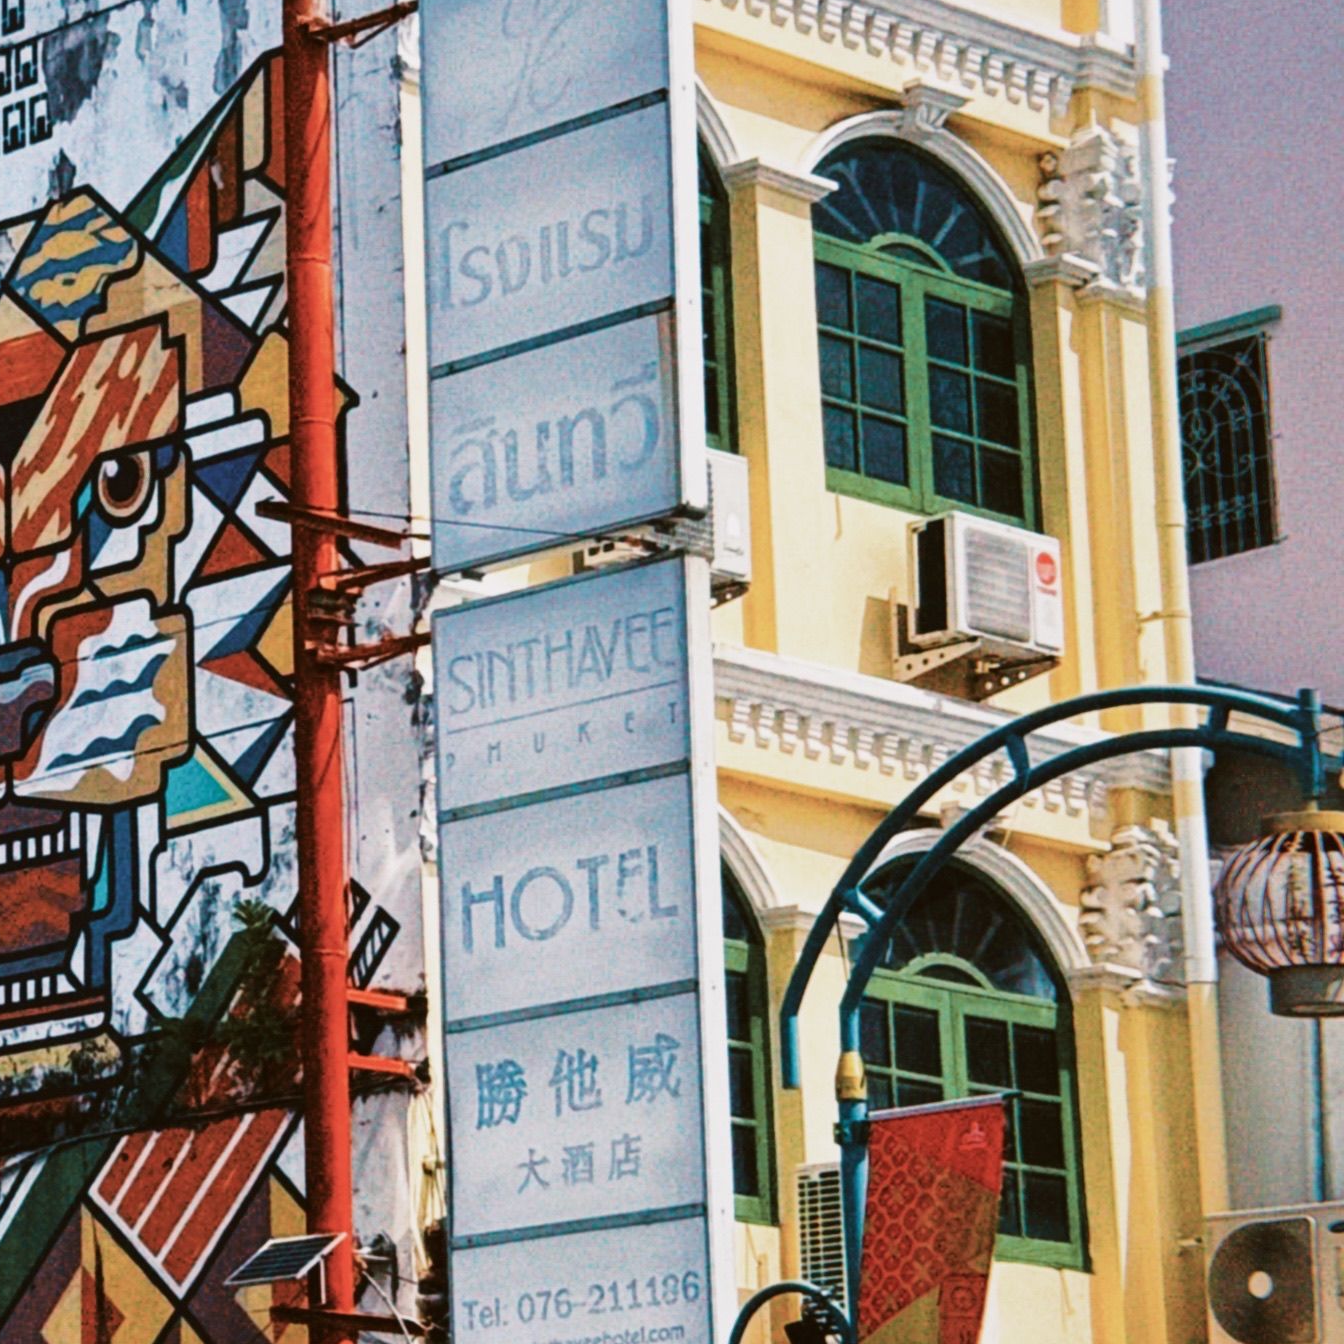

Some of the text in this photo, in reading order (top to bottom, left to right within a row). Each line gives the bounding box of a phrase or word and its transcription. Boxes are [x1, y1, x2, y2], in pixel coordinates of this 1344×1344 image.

[435, 193, 654, 313] โรงแรม
[447, 607, 677, 715] SINTHAVEE
[460, 845, 679, 954] HOTEL
[475, 1032, 683, 1130] 勝他威
[517, 1133, 644, 1195] 大酒店
[517, 1270, 702, 1324] 076-211186
